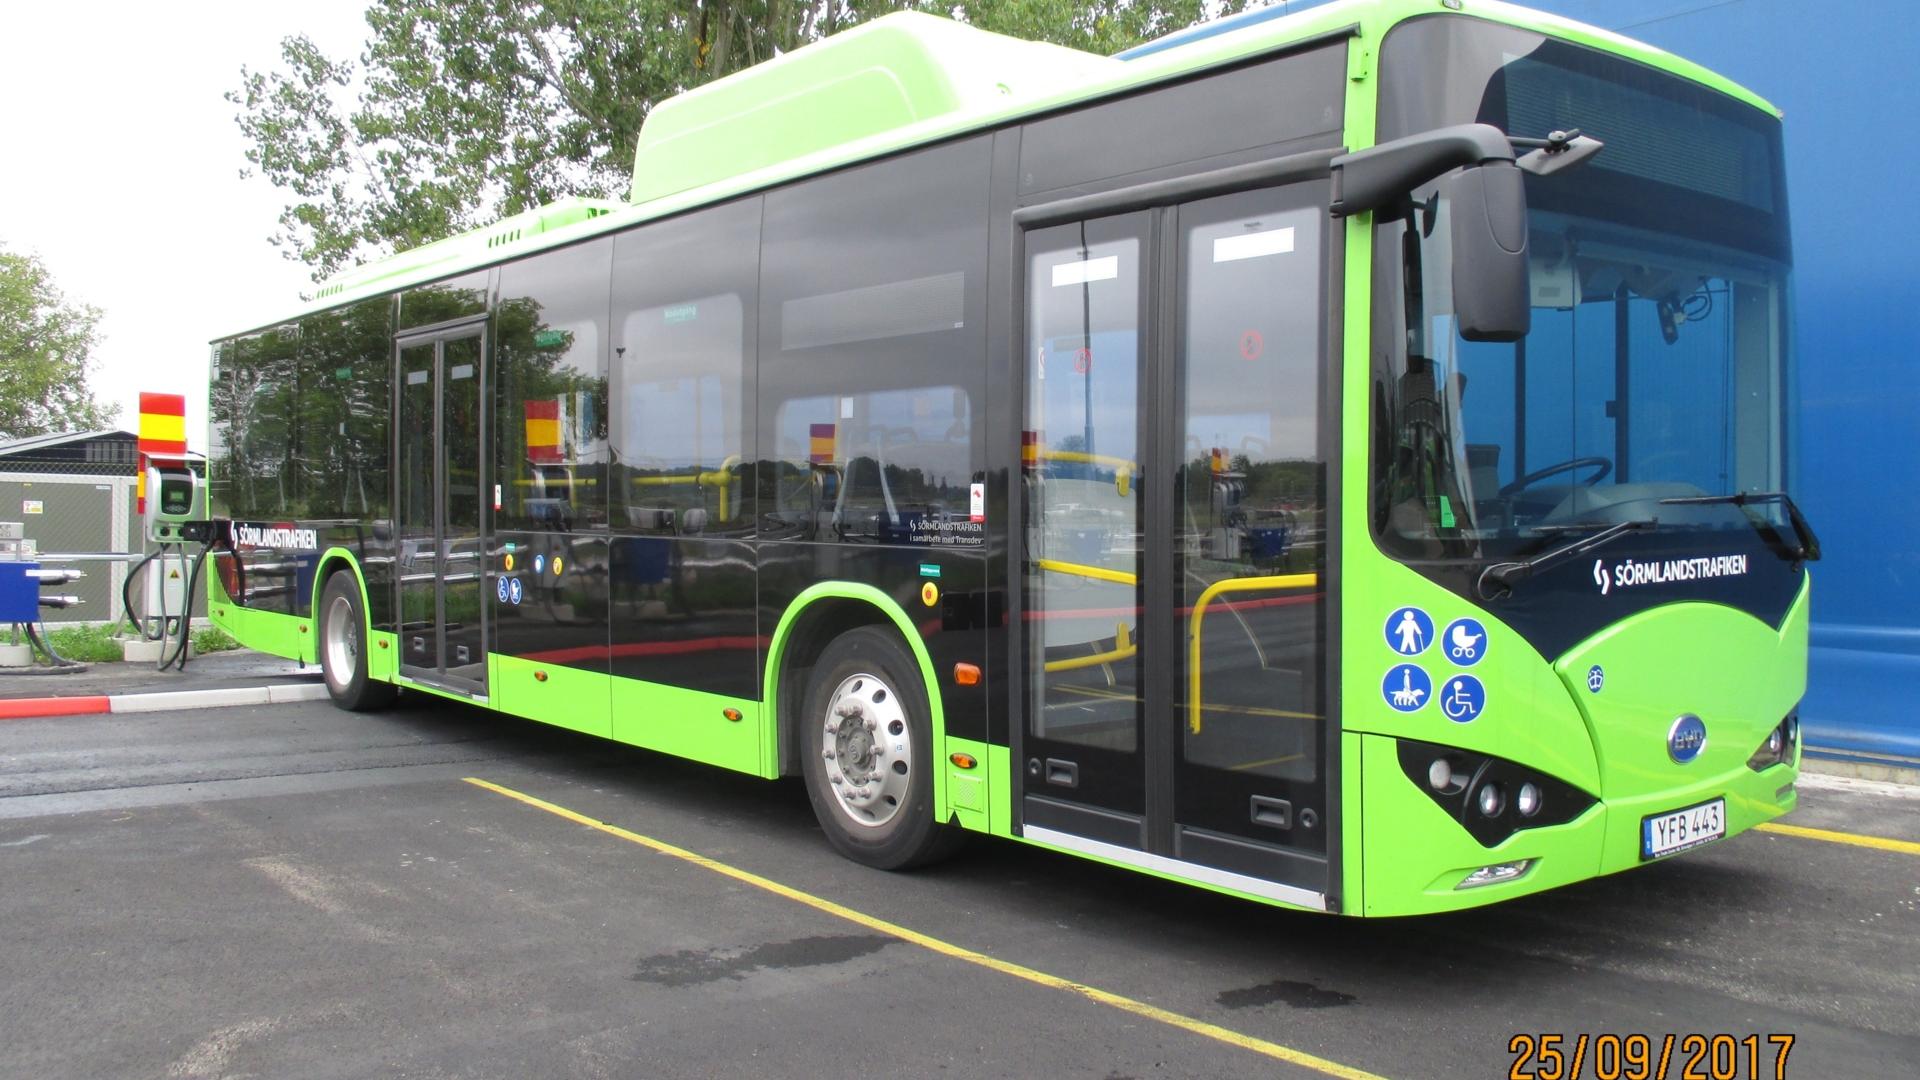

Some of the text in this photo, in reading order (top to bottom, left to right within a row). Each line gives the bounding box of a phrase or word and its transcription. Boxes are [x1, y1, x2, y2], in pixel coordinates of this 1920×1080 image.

[239, 523, 317, 549] SÖRMLANDSTRAFIKEN
[918, 520, 982, 532] SÖRMLANDSTRAFIKEN
[942, 535, 955, 544] med
[956, 535, 982, 544] Transdev
[1614, 554, 1747, 587] SÖRMLANDSTRAFIKEN
[1657, 814, 1687, 847] YFB
[1691, 805, 1719, 836] 443
